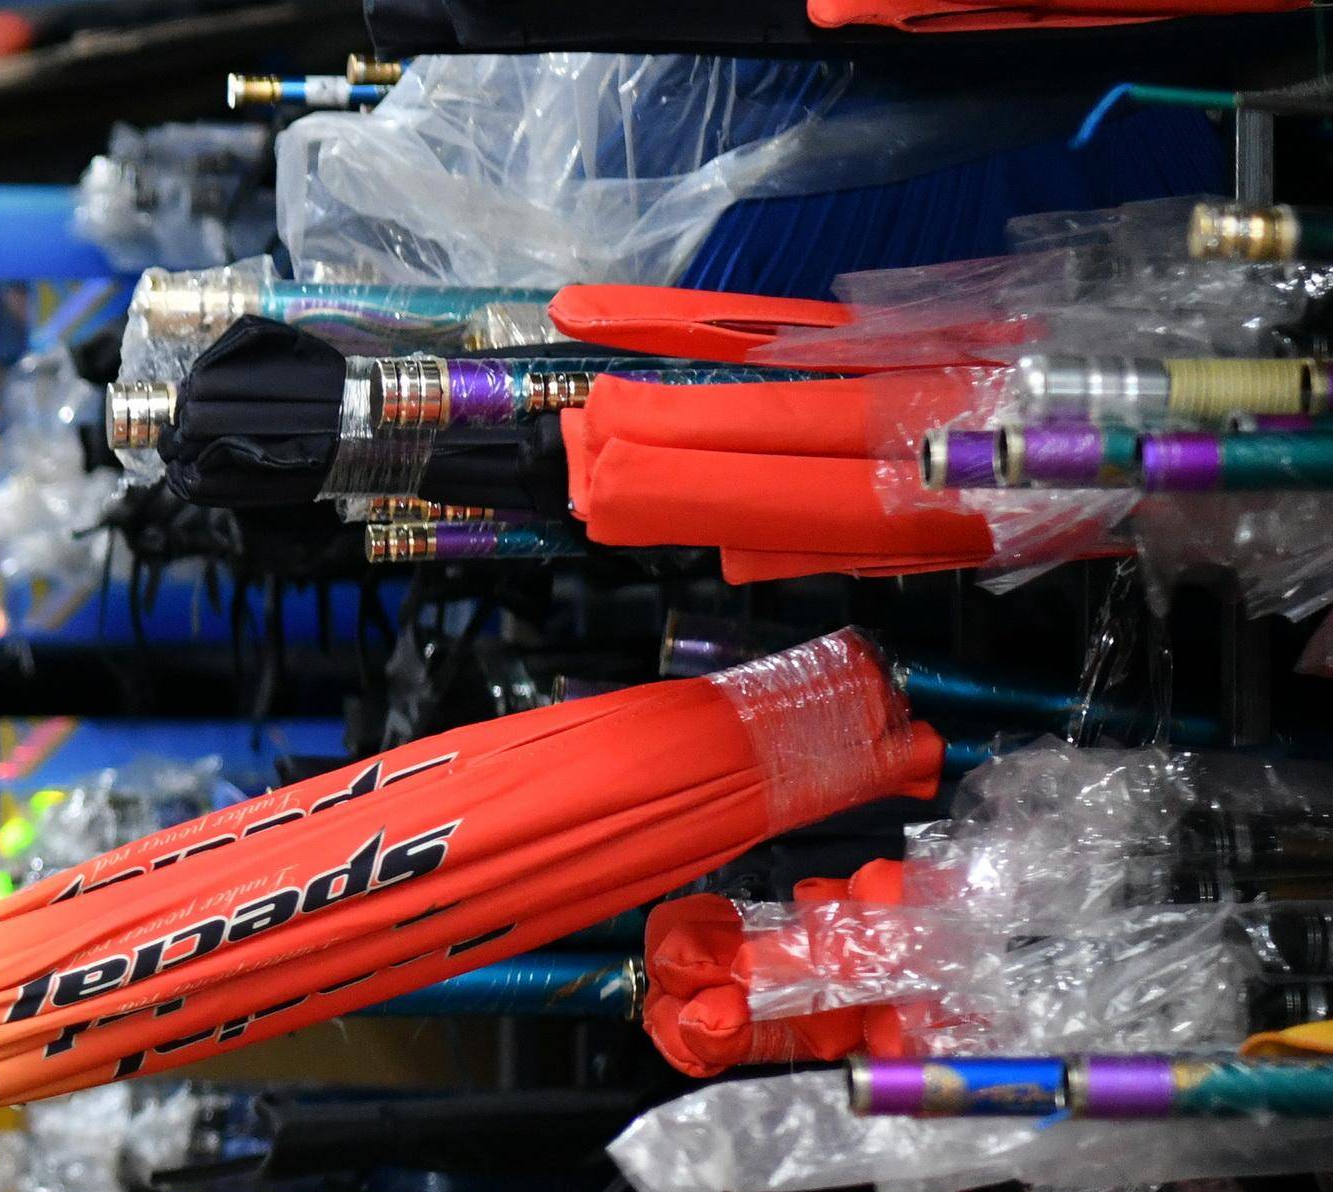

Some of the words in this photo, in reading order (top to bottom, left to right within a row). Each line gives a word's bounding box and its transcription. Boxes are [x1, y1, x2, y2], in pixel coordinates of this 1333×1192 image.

[136, 815, 210, 853] power
[89, 849, 134, 882] rod
[119, 896, 198, 945] power
